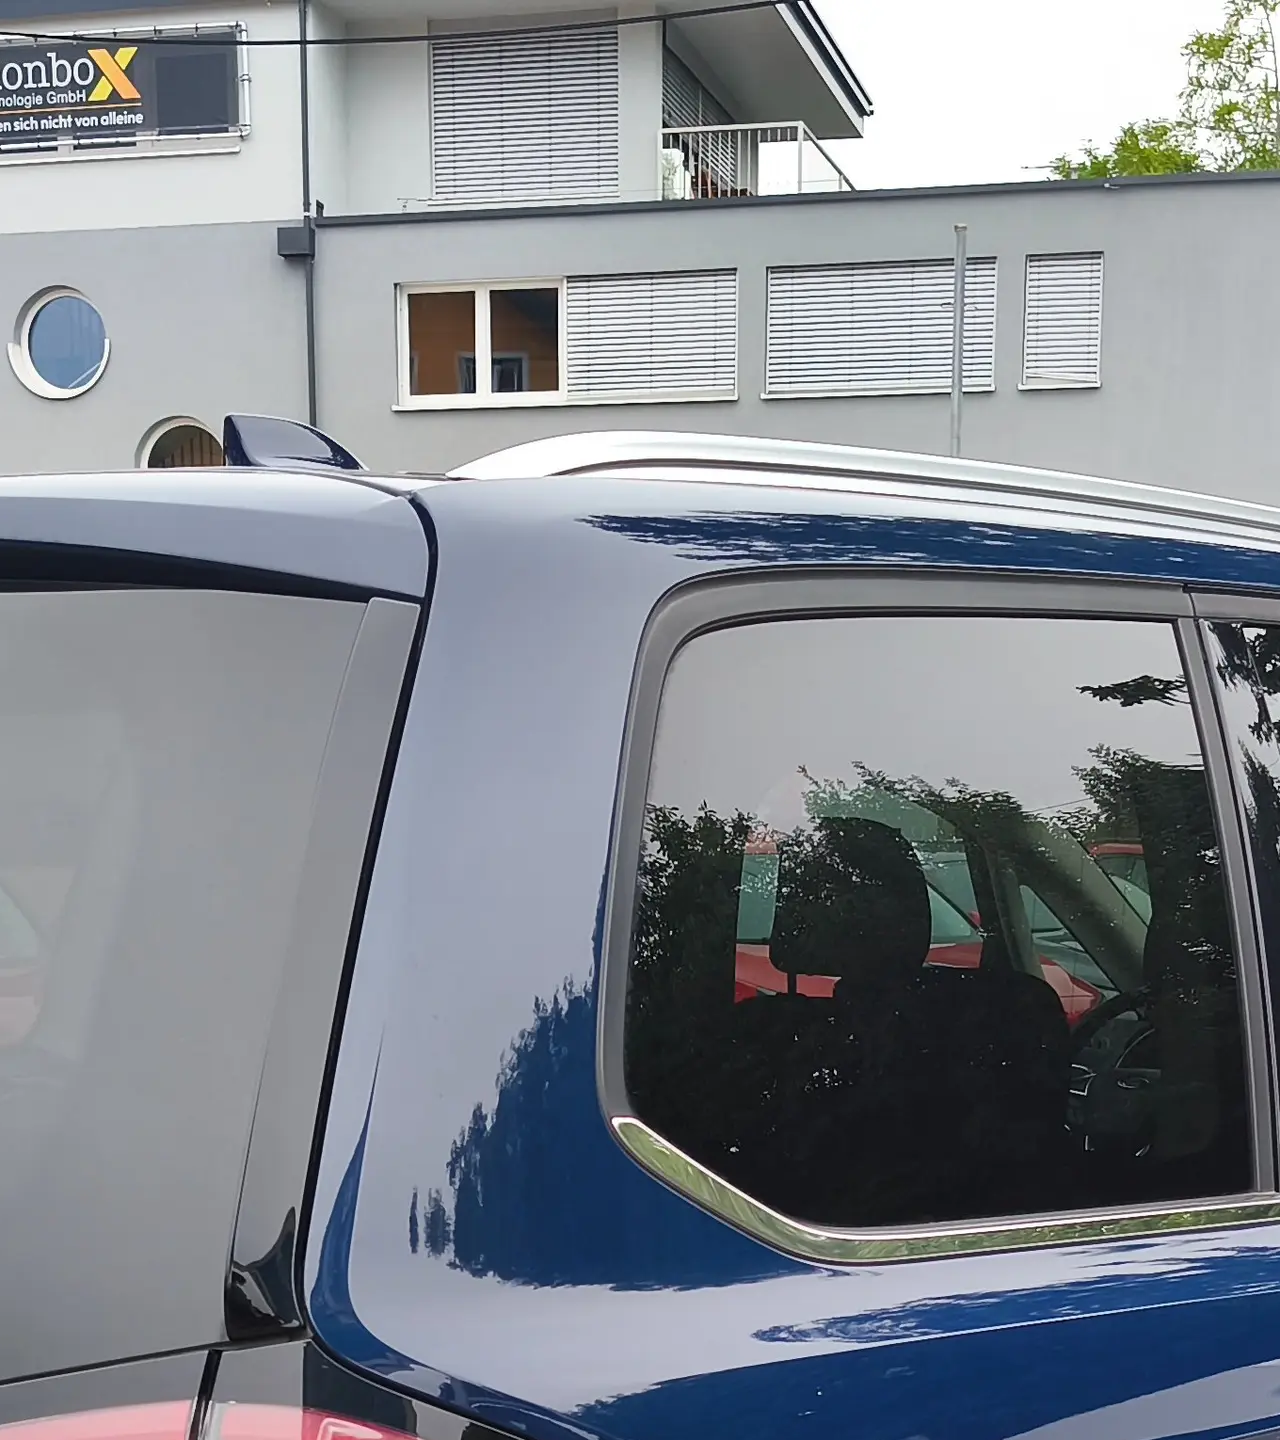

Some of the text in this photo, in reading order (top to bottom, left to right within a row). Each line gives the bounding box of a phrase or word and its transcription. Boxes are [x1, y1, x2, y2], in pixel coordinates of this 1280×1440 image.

[46, 89, 86, 104] GmbH
[13, 116, 39, 131] sich
[40, 113, 73, 130] nicht
[75, 115, 99, 128] von
[100, 110, 144, 125] alleine
